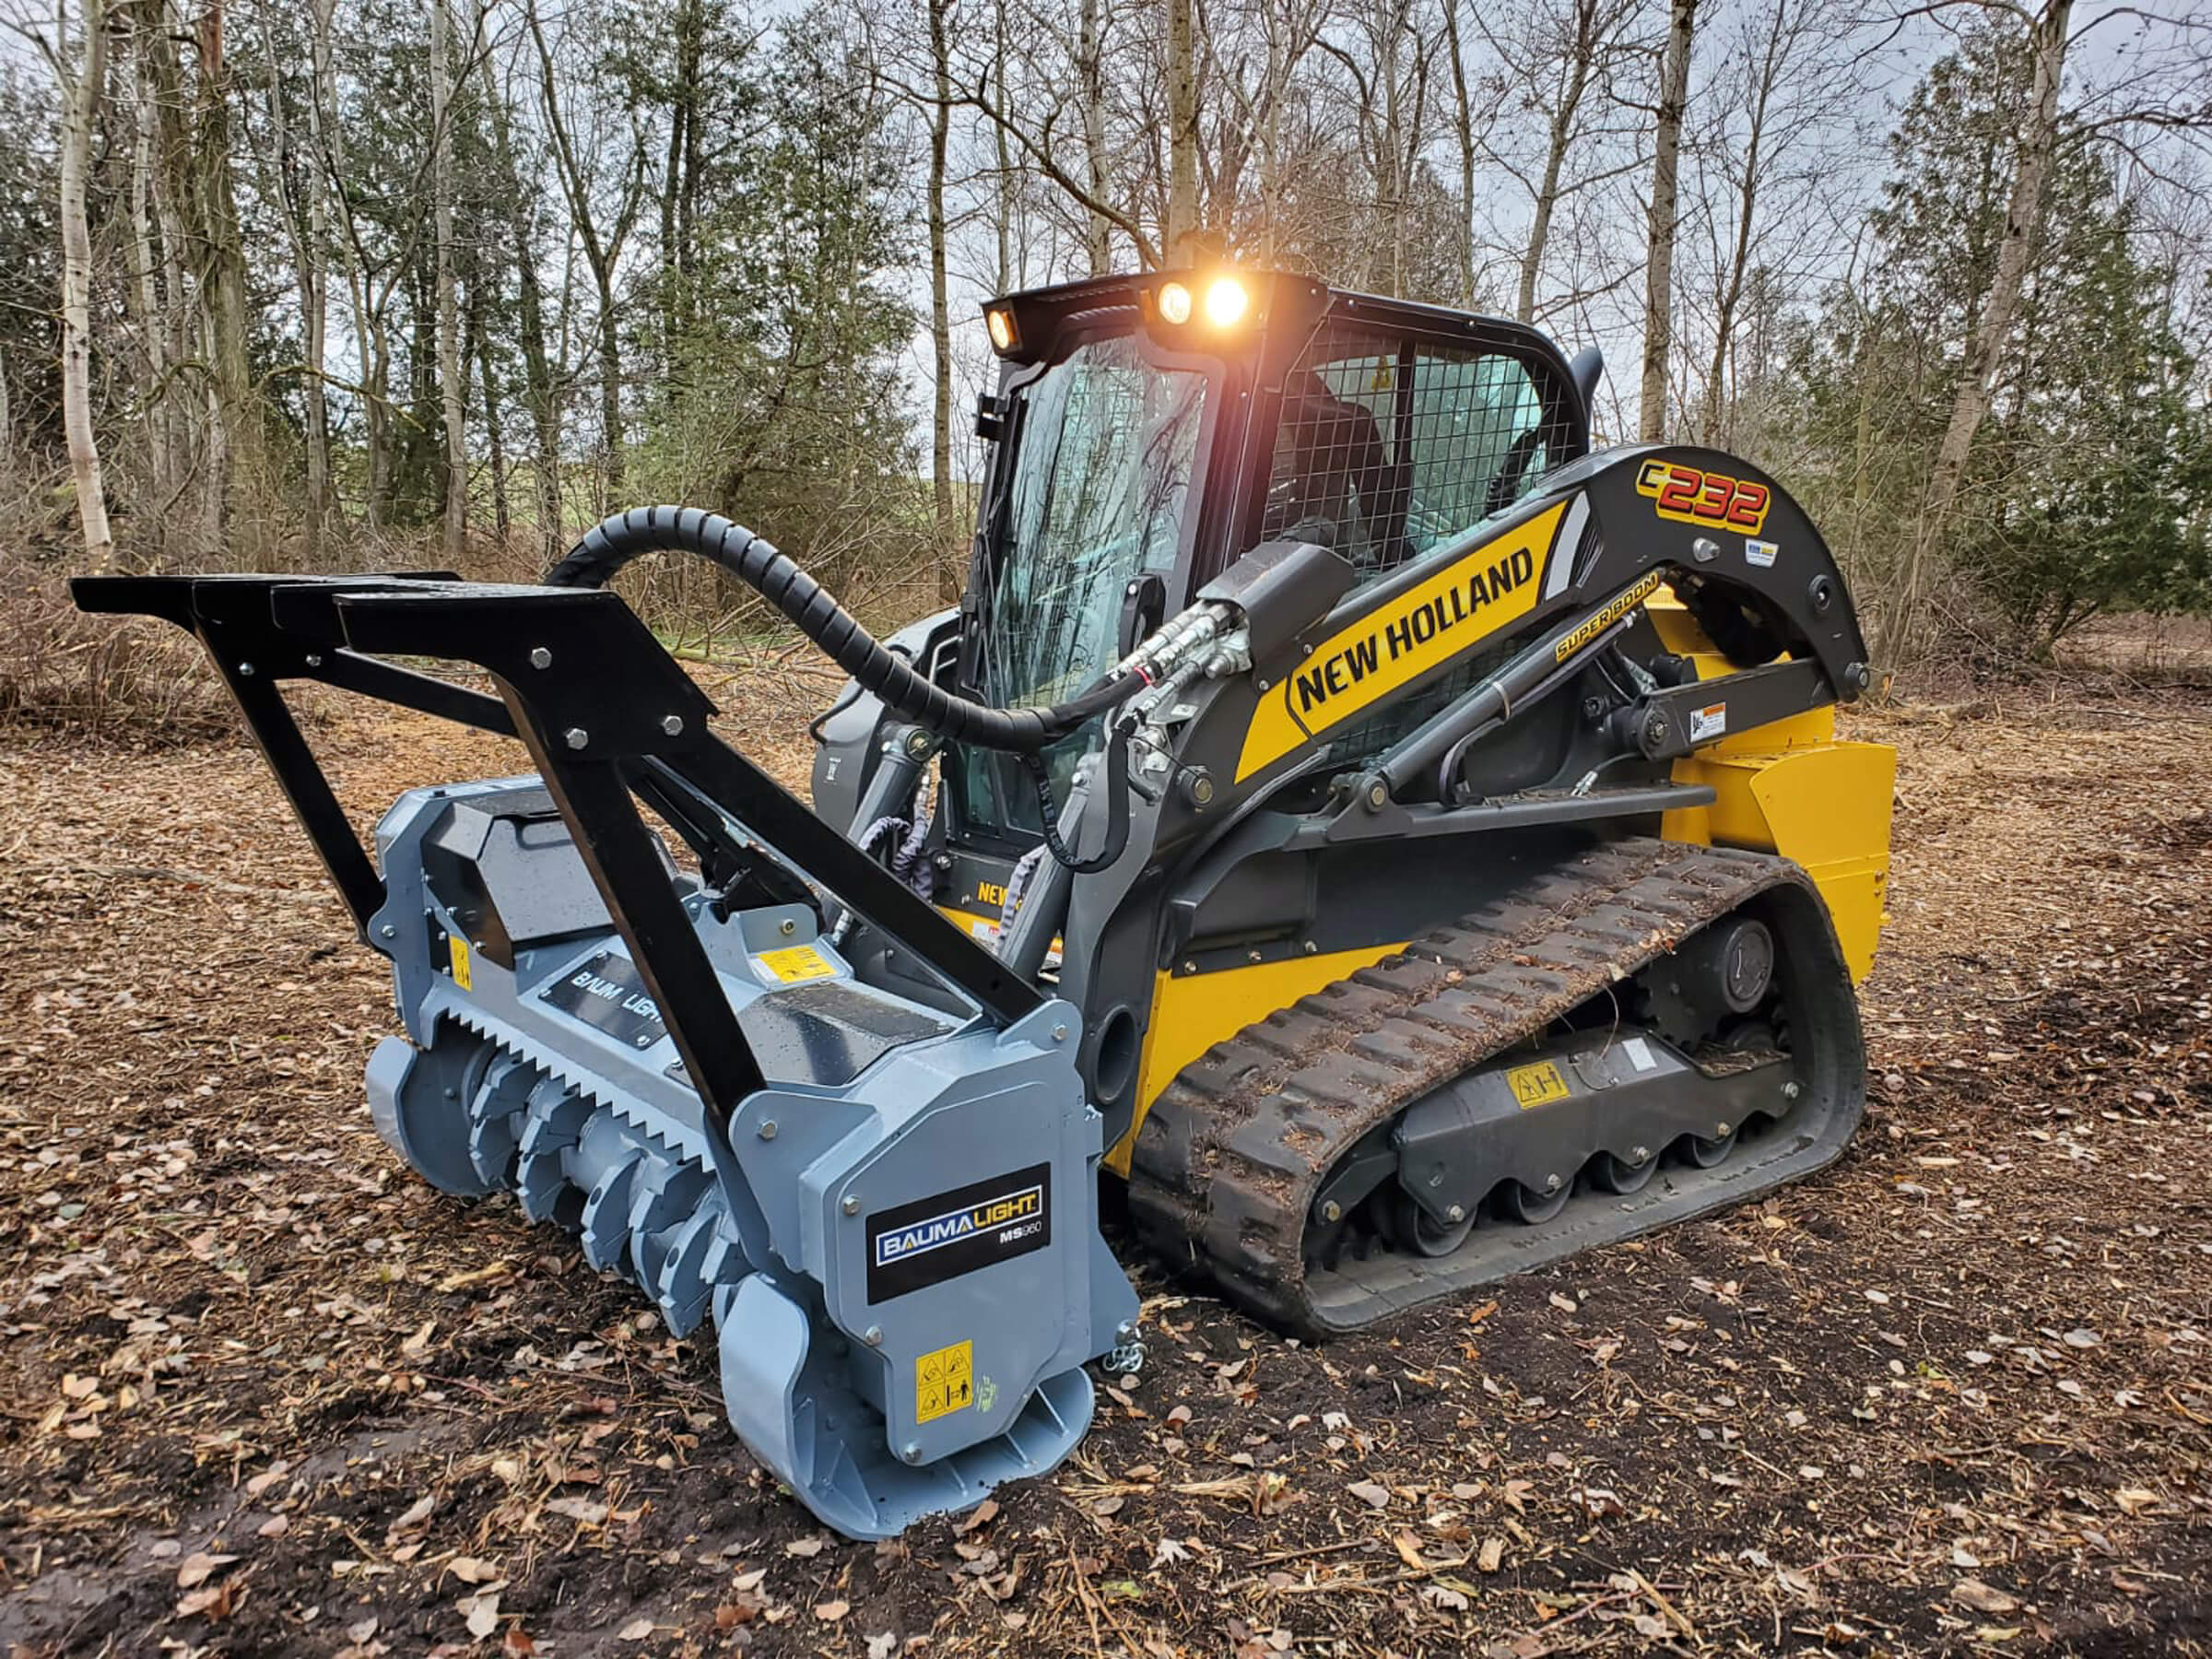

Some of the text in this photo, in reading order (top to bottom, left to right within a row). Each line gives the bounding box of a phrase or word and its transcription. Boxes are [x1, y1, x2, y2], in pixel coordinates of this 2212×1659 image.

[1638, 463, 1767, 527] C232
[1296, 547, 1533, 713] NEW HOLLAND
[1558, 573, 1657, 656] SUPER BOOM
[571, 971, 624, 1001] BAUM
[883, 1194, 1037, 1257] BAUMALIGHT
[999, 1220, 1041, 1244] MS960
